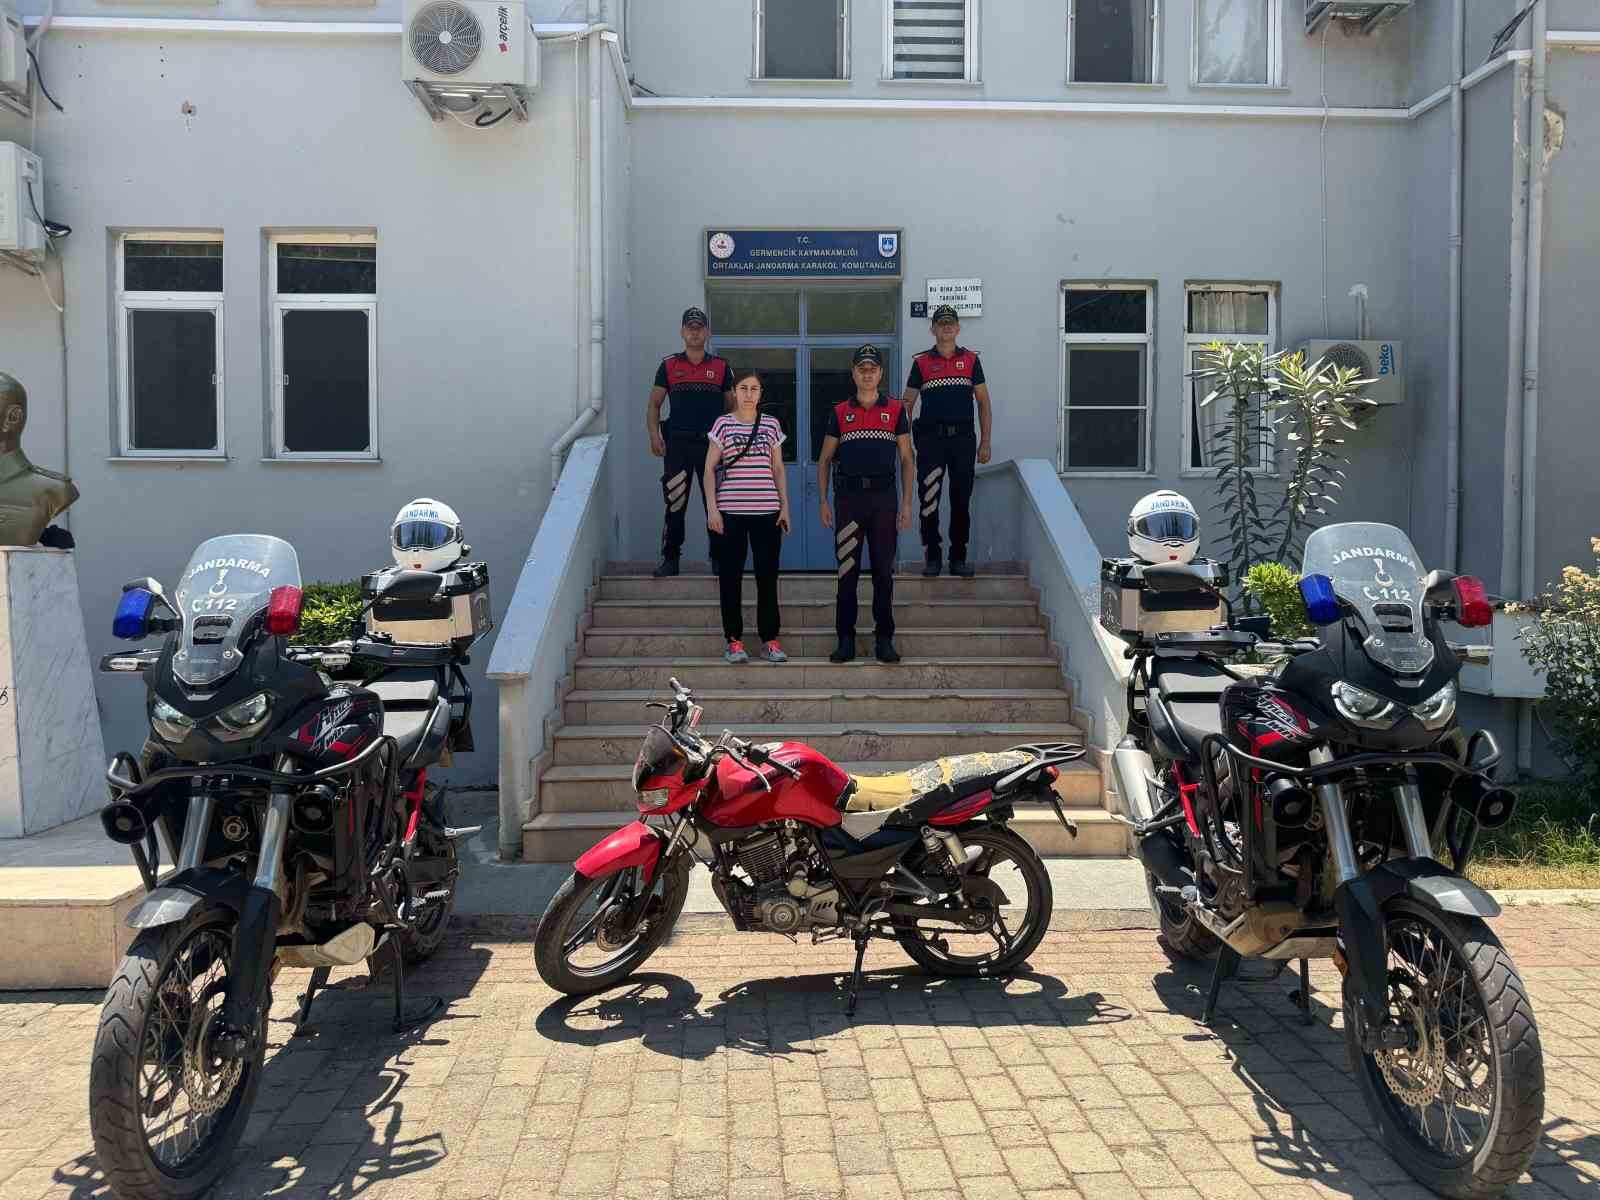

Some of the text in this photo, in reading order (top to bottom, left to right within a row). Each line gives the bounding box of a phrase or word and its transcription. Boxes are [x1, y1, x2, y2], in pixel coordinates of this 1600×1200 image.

[799, 248, 858, 257] KAYMAKAMLIĞI
[712, 261, 896, 270] ORTAKLAR JANDARMA KARAKOL KOMUTANLIĞI
[1377, 344, 1389, 375] beko
[188, 558, 272, 578] JANDARMA
[1331, 547, 1417, 571] JANDARMA
